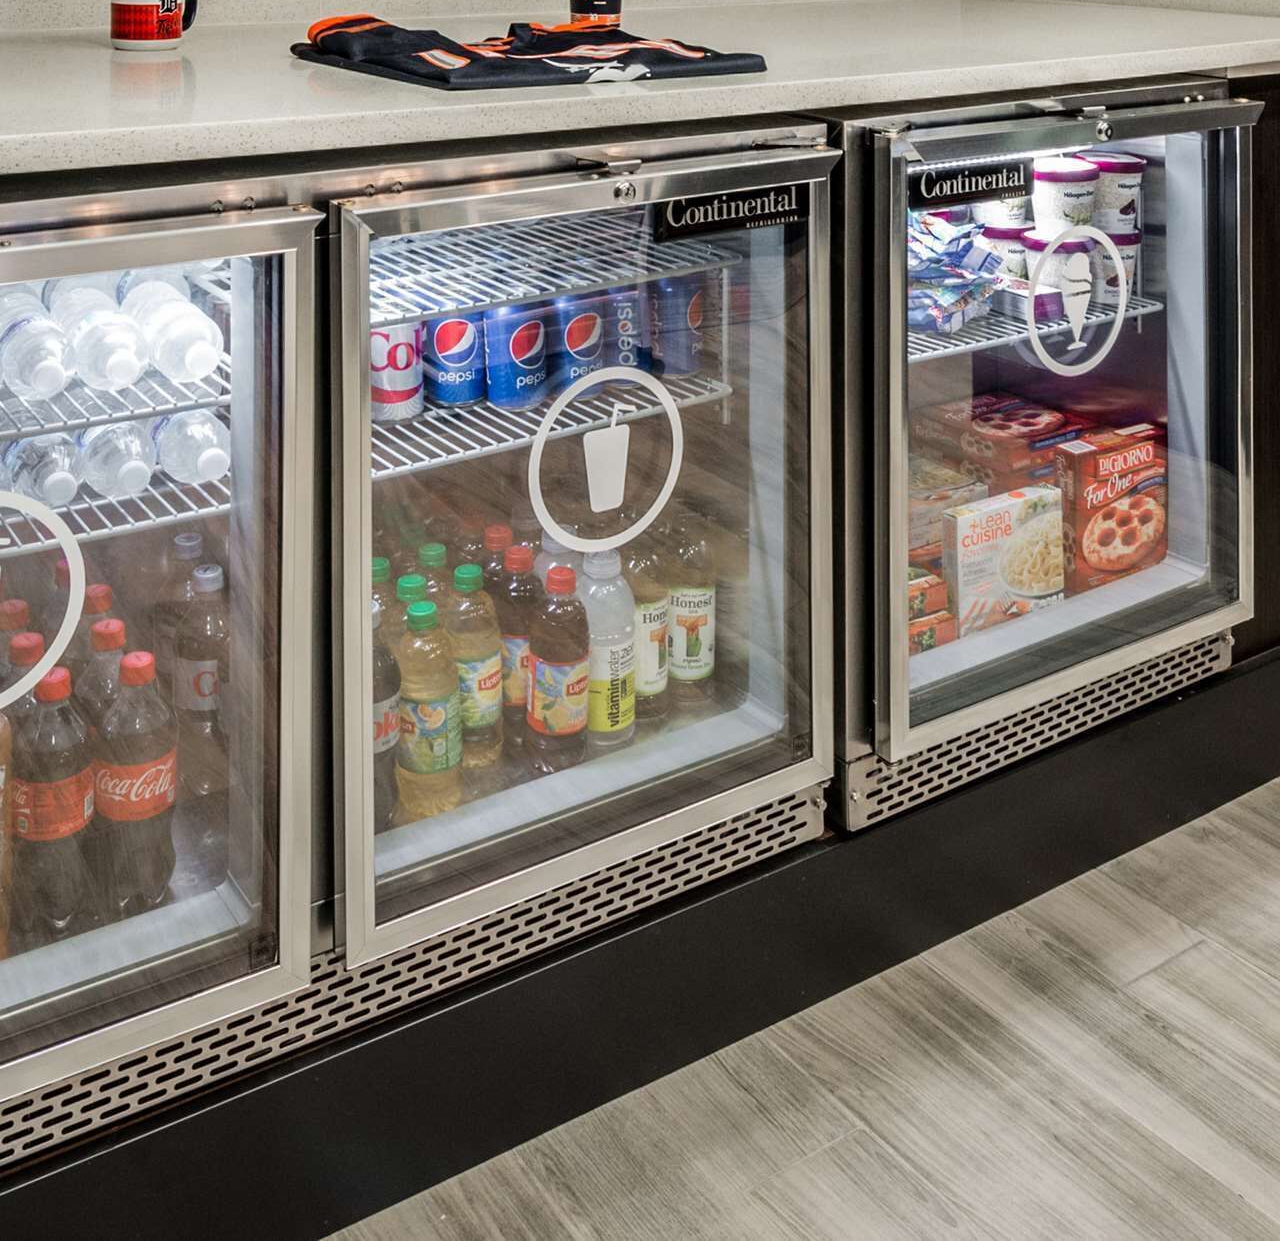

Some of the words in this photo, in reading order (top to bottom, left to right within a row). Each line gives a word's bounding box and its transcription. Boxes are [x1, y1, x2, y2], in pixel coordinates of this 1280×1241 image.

[921, 164, 1024, 198] Continental
[667, 186, 798, 227] Continental
[438, 370, 475, 386] pepsi
[516, 370, 546, 390] peps
[1084, 481, 1107, 510] For
[1107, 473, 1133, 498] One
